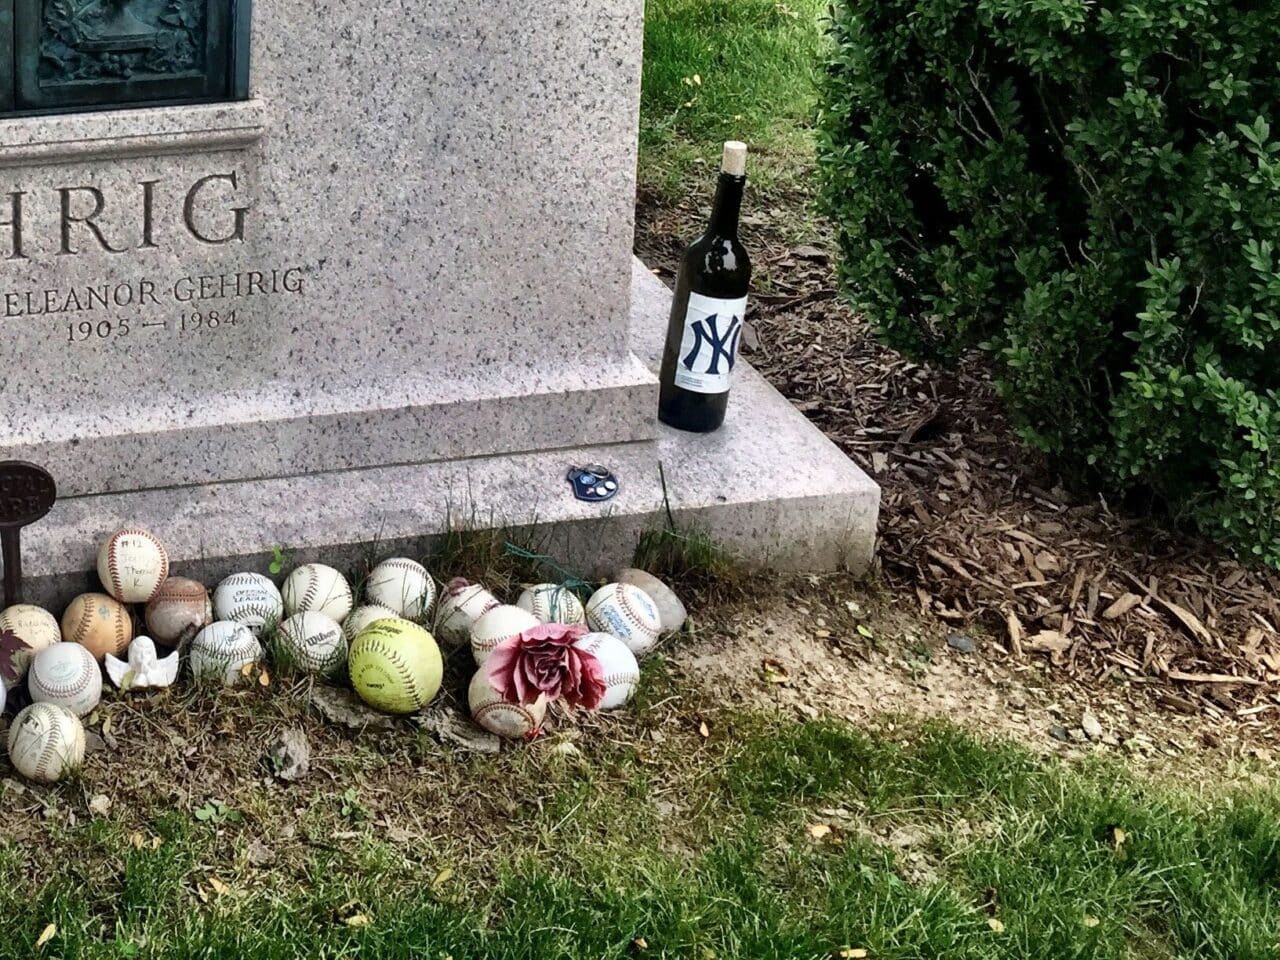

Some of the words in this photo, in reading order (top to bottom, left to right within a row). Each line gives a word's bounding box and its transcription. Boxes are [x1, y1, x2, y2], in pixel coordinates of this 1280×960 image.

[4, 280, 161, 318] ELEANOR
[173, 267, 305, 302] GEHRIG
[68, 318, 130, 341] 1905
[180, 310, 237, 331] 1984
[683, 313, 741, 375] NY
[306, 629, 336, 646] Wilson
